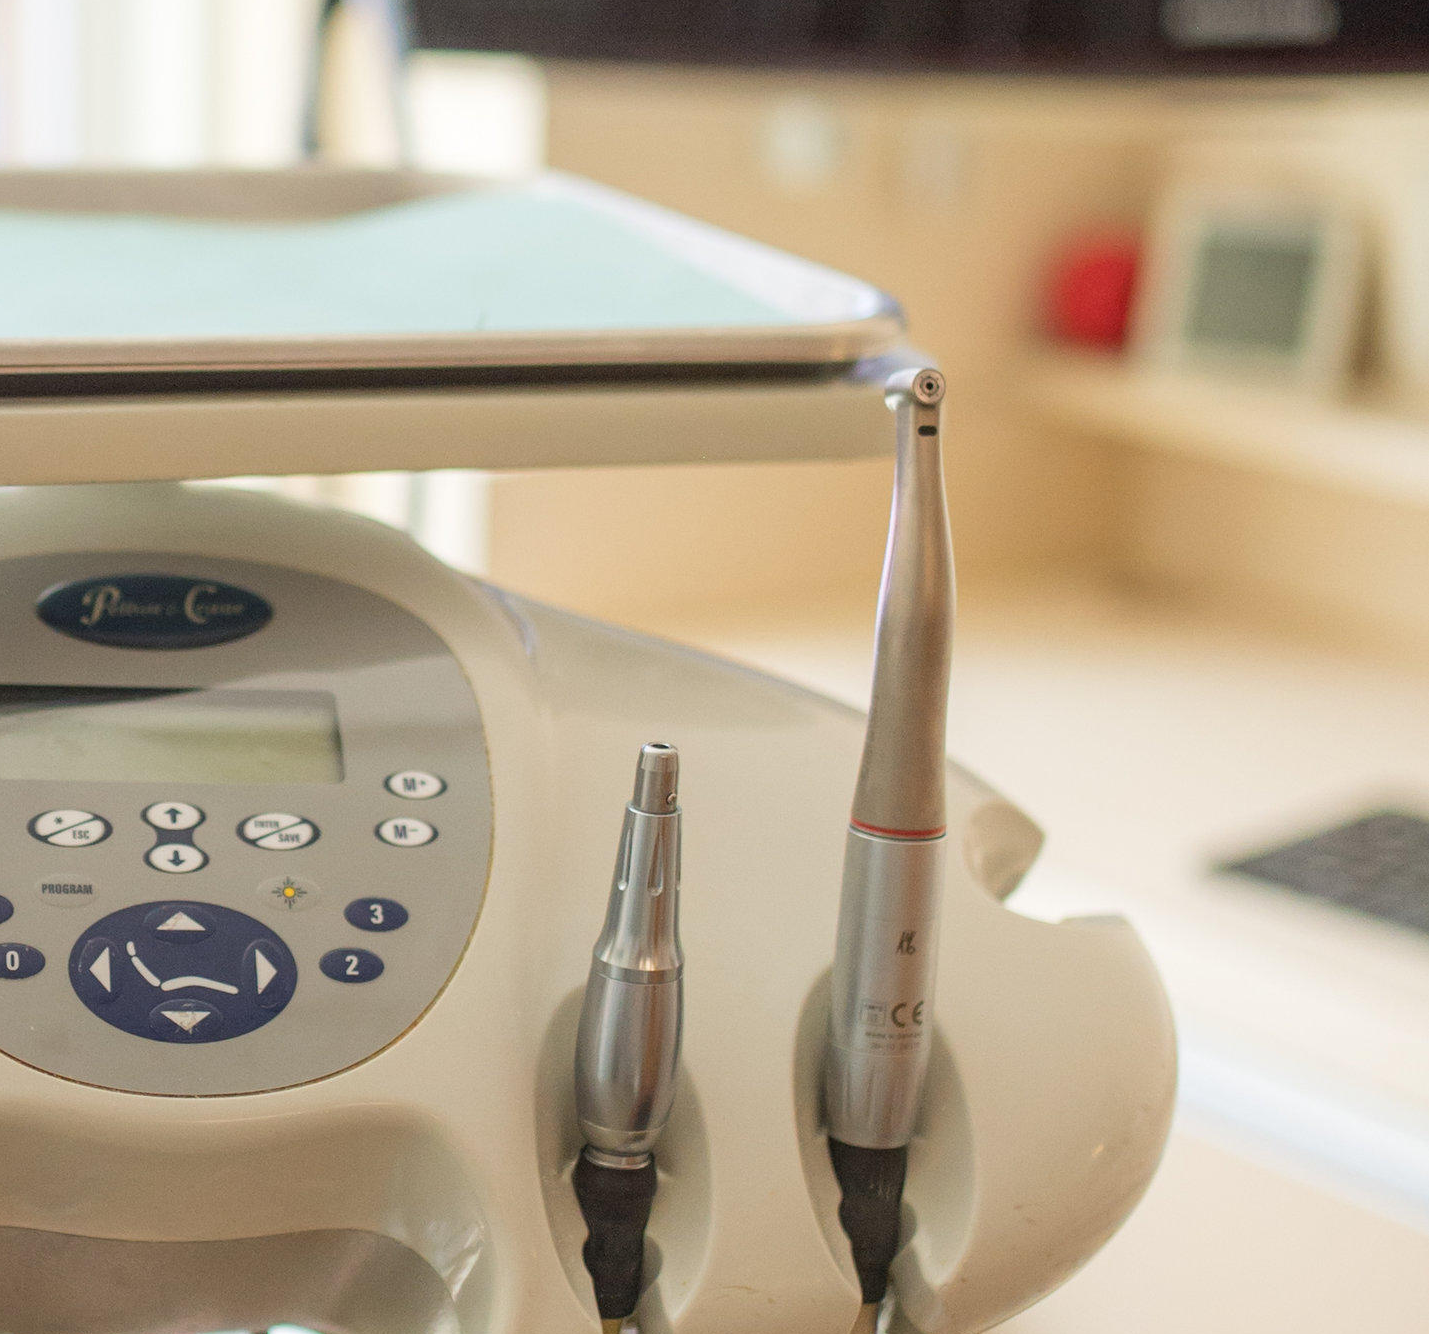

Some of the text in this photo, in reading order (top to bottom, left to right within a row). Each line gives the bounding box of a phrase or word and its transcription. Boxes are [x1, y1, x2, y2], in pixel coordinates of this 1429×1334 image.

[72, 830, 90, 840] ESC
[278, 833, 301, 844] SAVE
[41, 883, 94, 895] PROGRAM
[369, 903, 385, 925] 3
[5, 950, 20, 971] 0
[345, 954, 360, 976] 2
[891, 999, 924, 1028] CE
